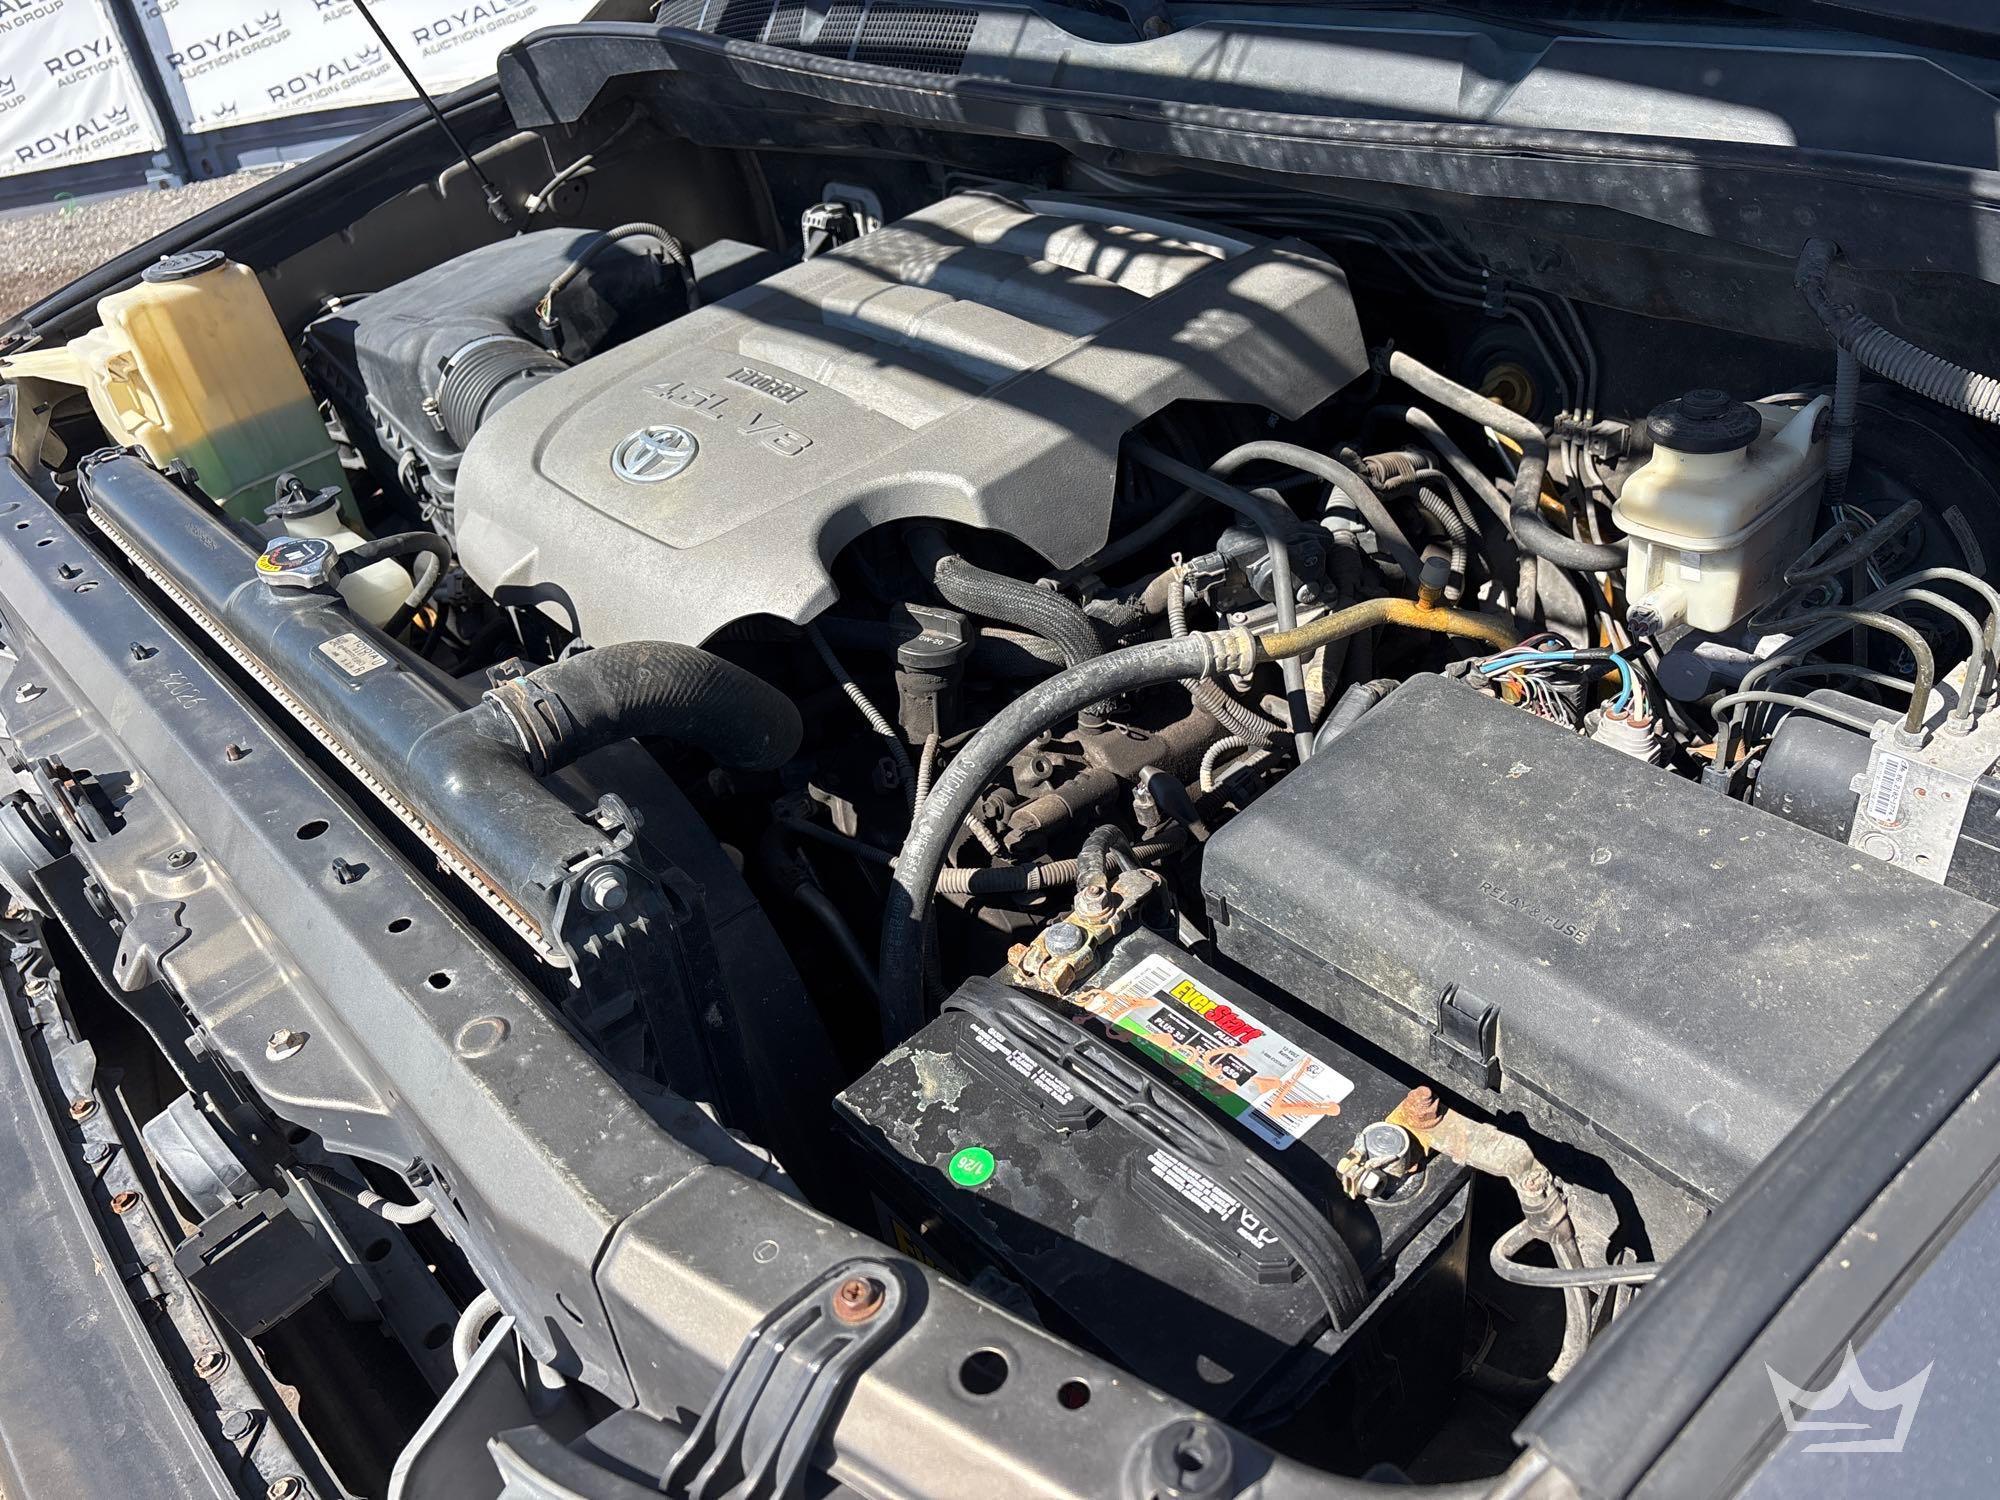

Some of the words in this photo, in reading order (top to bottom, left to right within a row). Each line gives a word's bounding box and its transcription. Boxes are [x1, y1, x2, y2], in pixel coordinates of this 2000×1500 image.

[241, 28, 292, 56] GROUP
[412, 0, 506, 45] ROYAL
[422, 27, 485, 59] AUCTION
[486, 5, 538, 32] GROUP
[166, 22, 259, 70] ROYAL
[57, 56, 120, 88] AUCTION
[268, 57, 360, 102] ROYAL
[341, 62, 391, 90] GROUP
[15, 117, 109, 163] ROYAL
[90, 123, 140, 149] GROUP
[737, 410, 813, 457] V8
[1478, 880, 1529, 913] RELAY
[1528, 905, 1541, 917] &
[1542, 913, 1587, 943] FUSE
[1153, 1017, 1177, 1034] PLUS
[1173, 1030, 1186, 1041] 35
[1168, 977, 1264, 1044] EverStart
[1212, 1030, 1237, 1047] PLUS
[1221, 1065, 1240, 1080] 650
